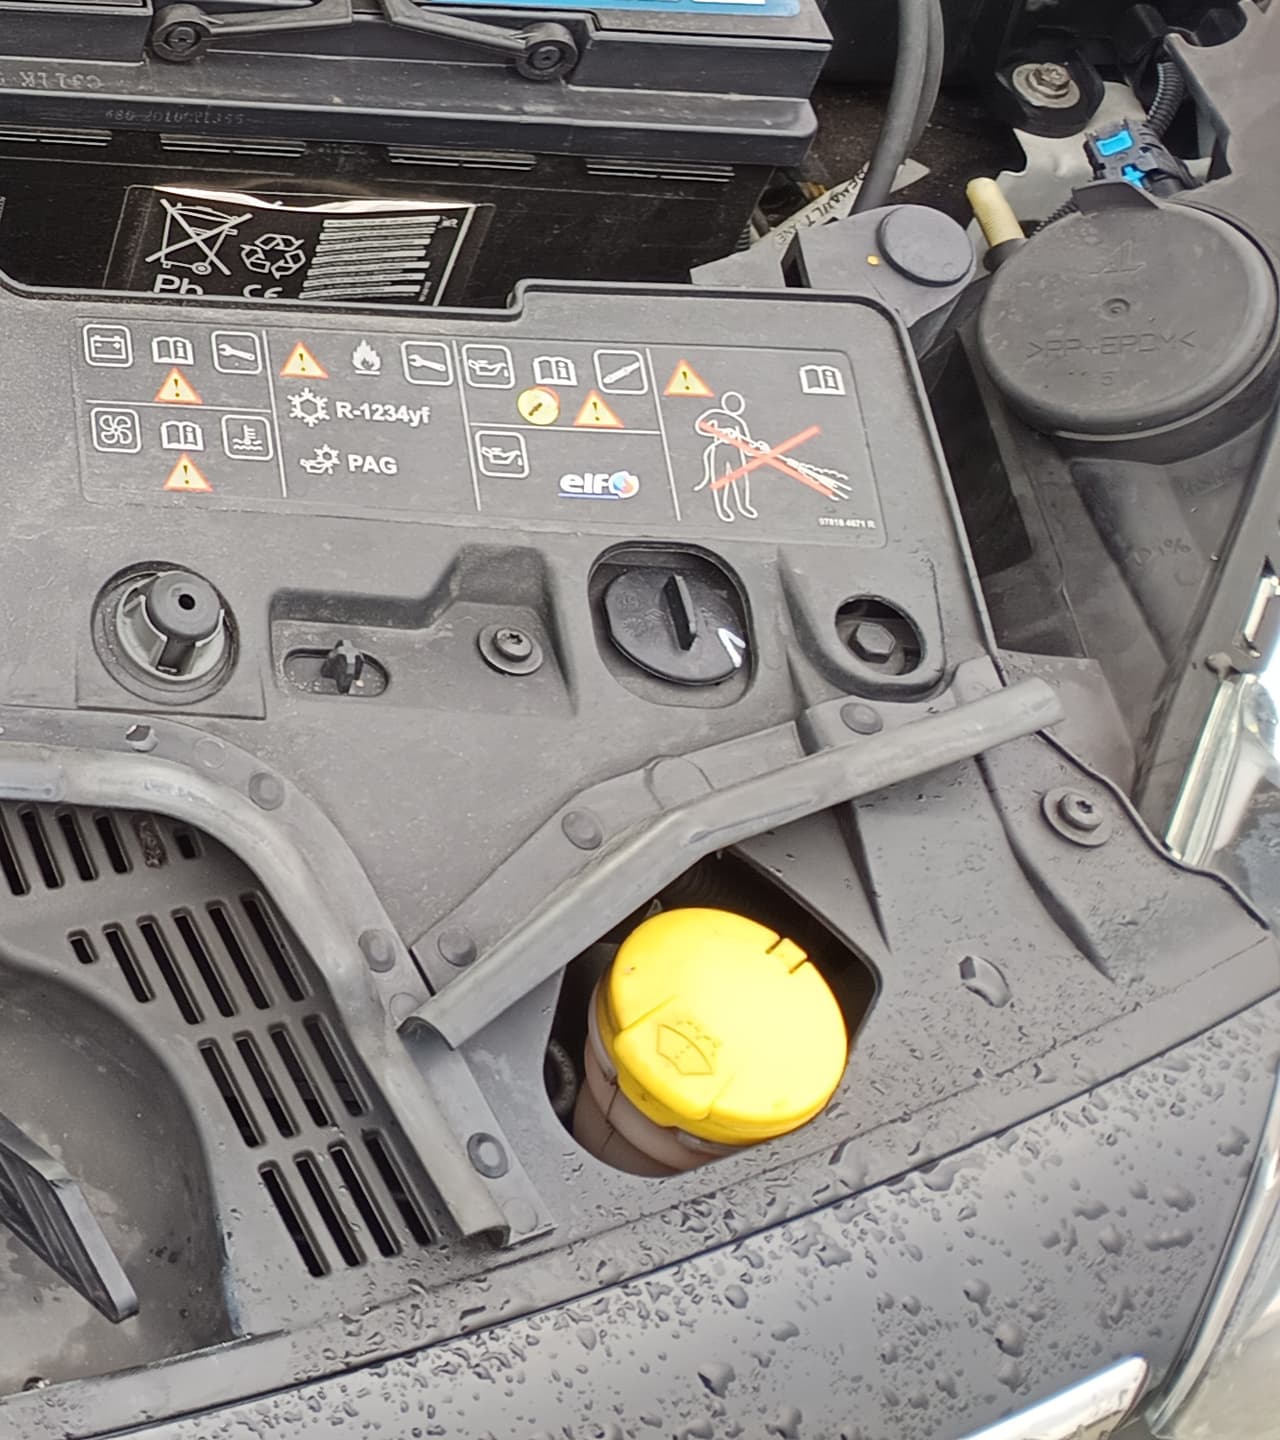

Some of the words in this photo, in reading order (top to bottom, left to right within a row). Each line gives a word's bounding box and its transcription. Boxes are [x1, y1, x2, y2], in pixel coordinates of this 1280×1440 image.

[335, 401, 431, 428] R-1234yf
[347, 454, 398, 475] PAG
[559, 472, 609, 495] elf
